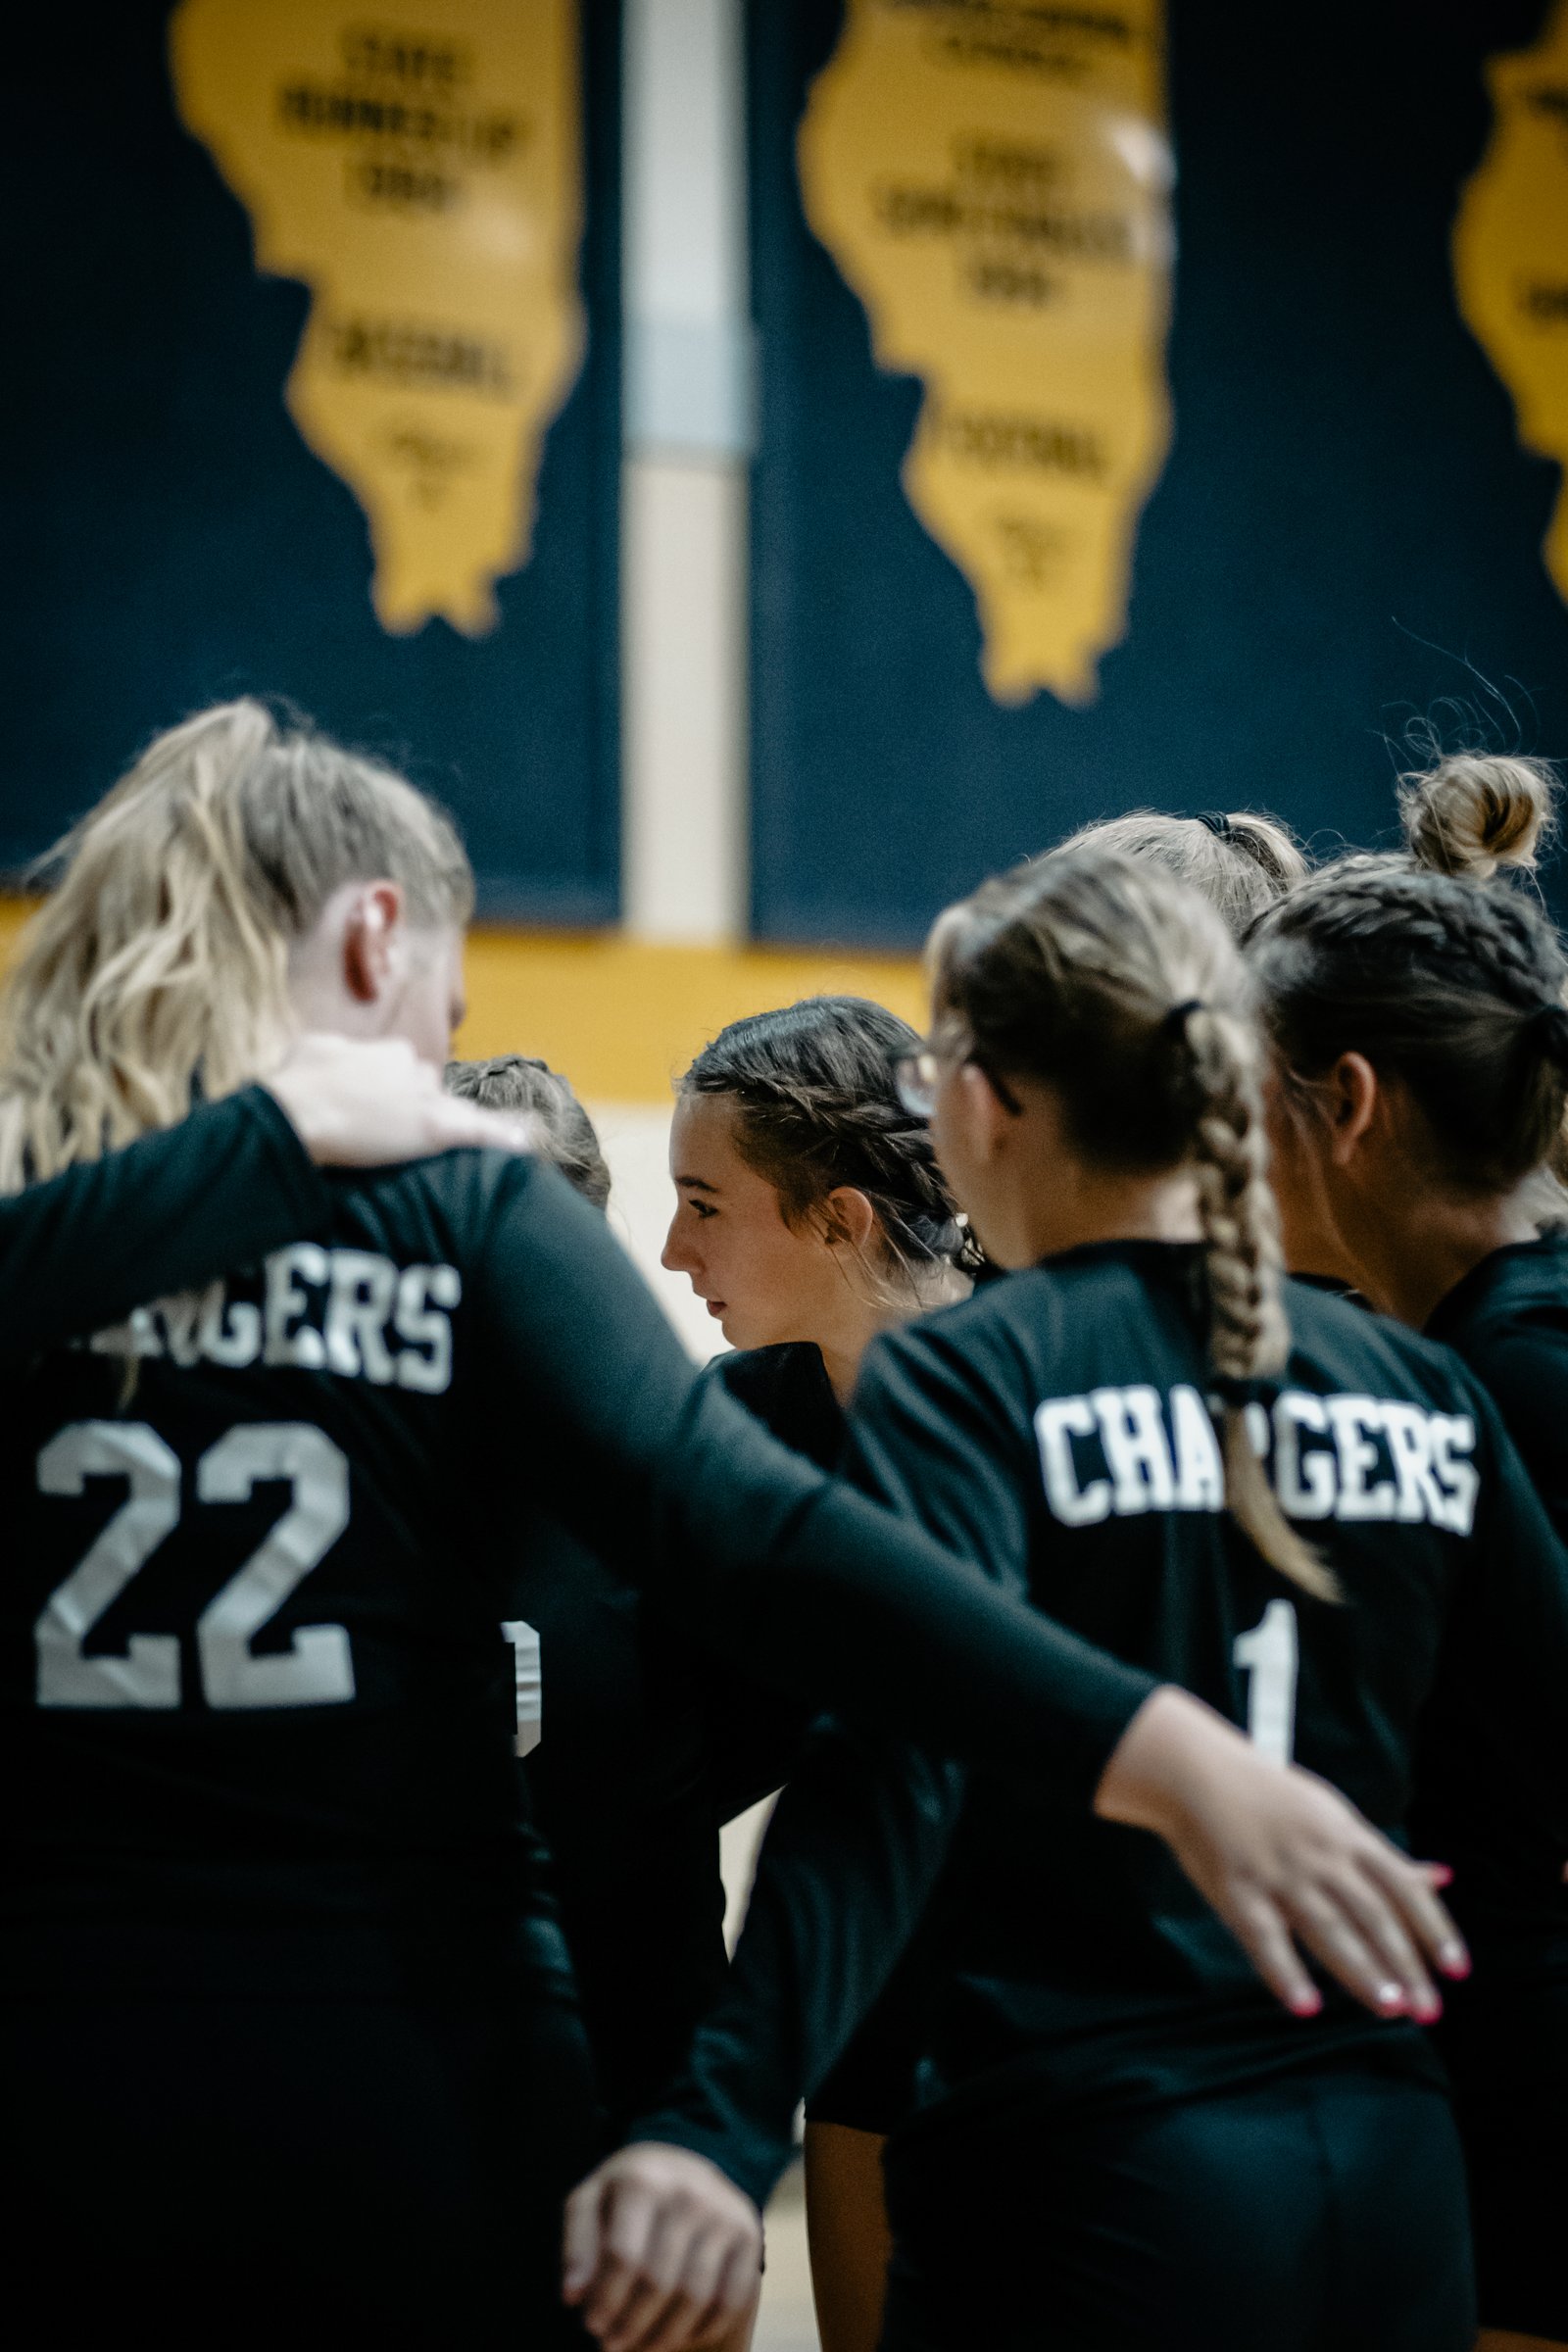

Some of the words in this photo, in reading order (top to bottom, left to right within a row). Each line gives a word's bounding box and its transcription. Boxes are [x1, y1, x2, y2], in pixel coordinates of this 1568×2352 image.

[90, 1242, 462, 1396] GERS
[1034, 1384, 1481, 1538] CHAGERS
[34, 1420, 356, 1709] 22
[1232, 1597, 1299, 1772] 1
